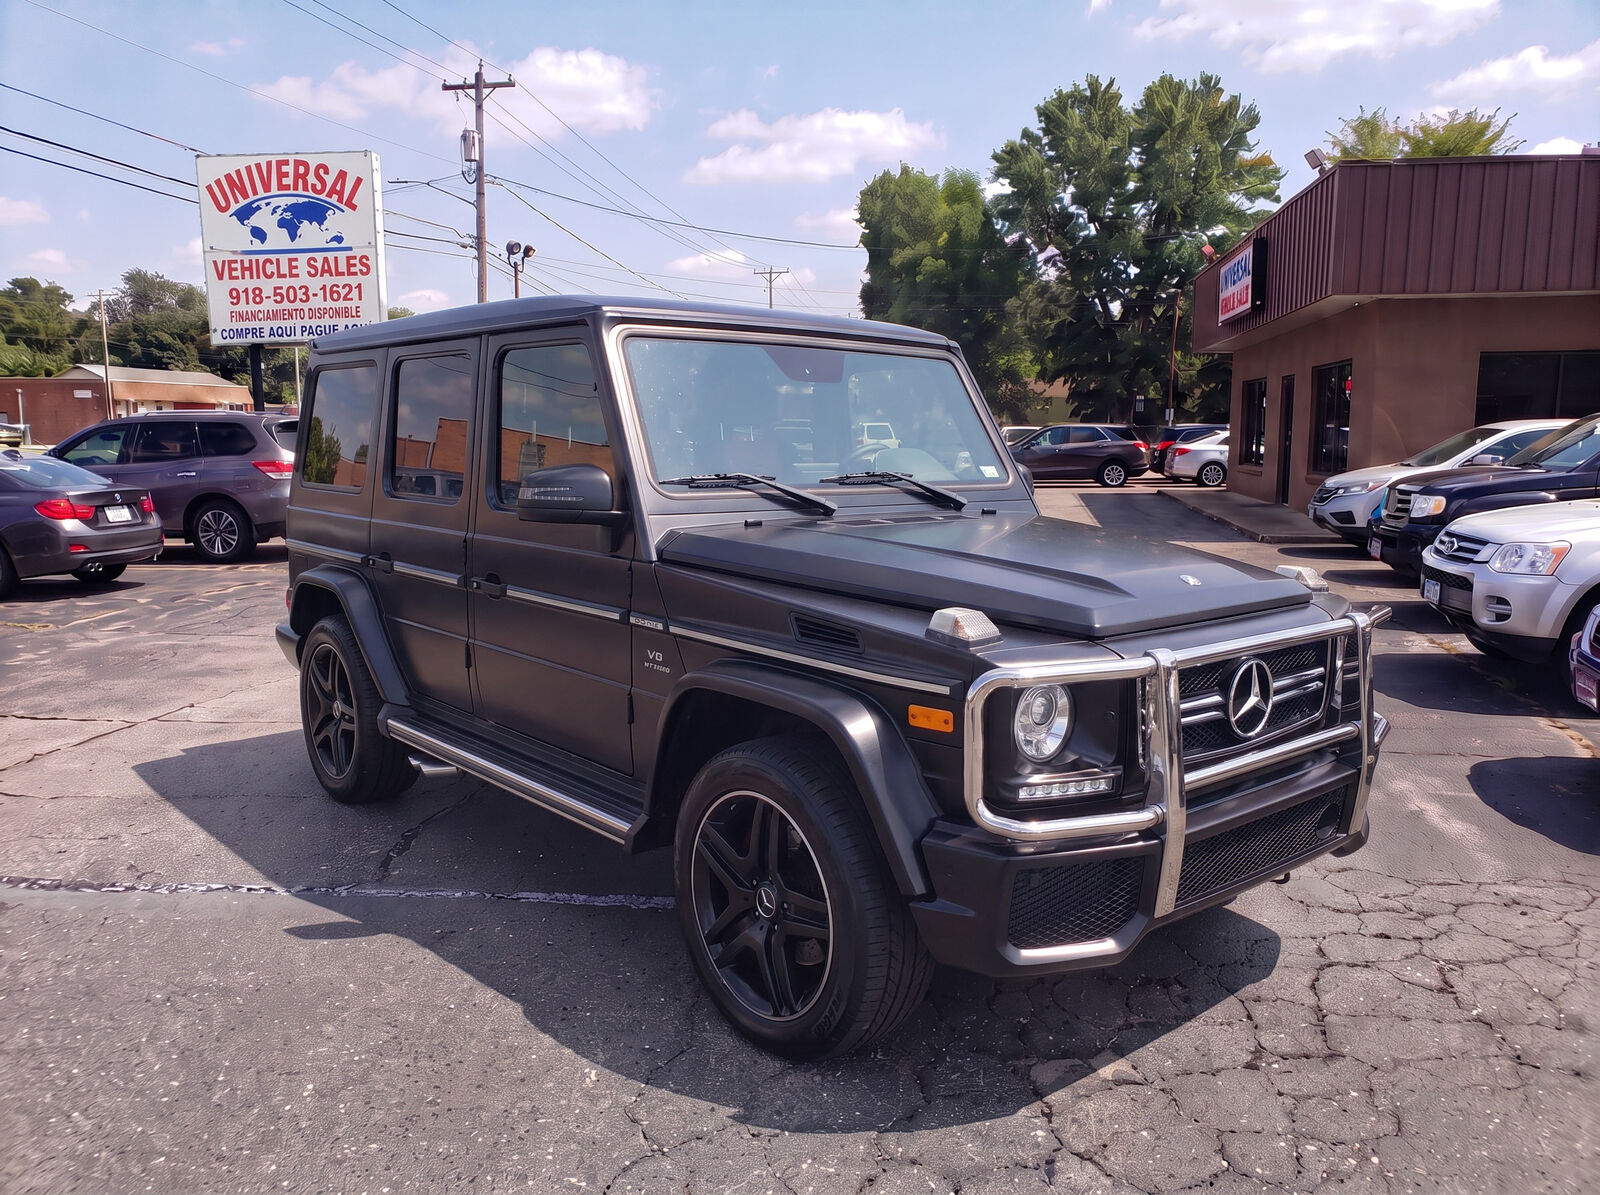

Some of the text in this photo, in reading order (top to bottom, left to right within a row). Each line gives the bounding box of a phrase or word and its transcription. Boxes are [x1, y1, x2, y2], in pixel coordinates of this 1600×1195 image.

[205, 159, 363, 213] UNIVERSAL
[212, 255, 371, 281] VEHICLE SALES
[228, 283, 363, 306] 918-503-1621
[230, 306, 361, 323] FINANCIAMIENTO DISPONIBLE
[221, 325, 265, 340] COMPRE
[268, 322, 296, 338] AQUÍ
[300, 323, 339, 337] PAGUE
